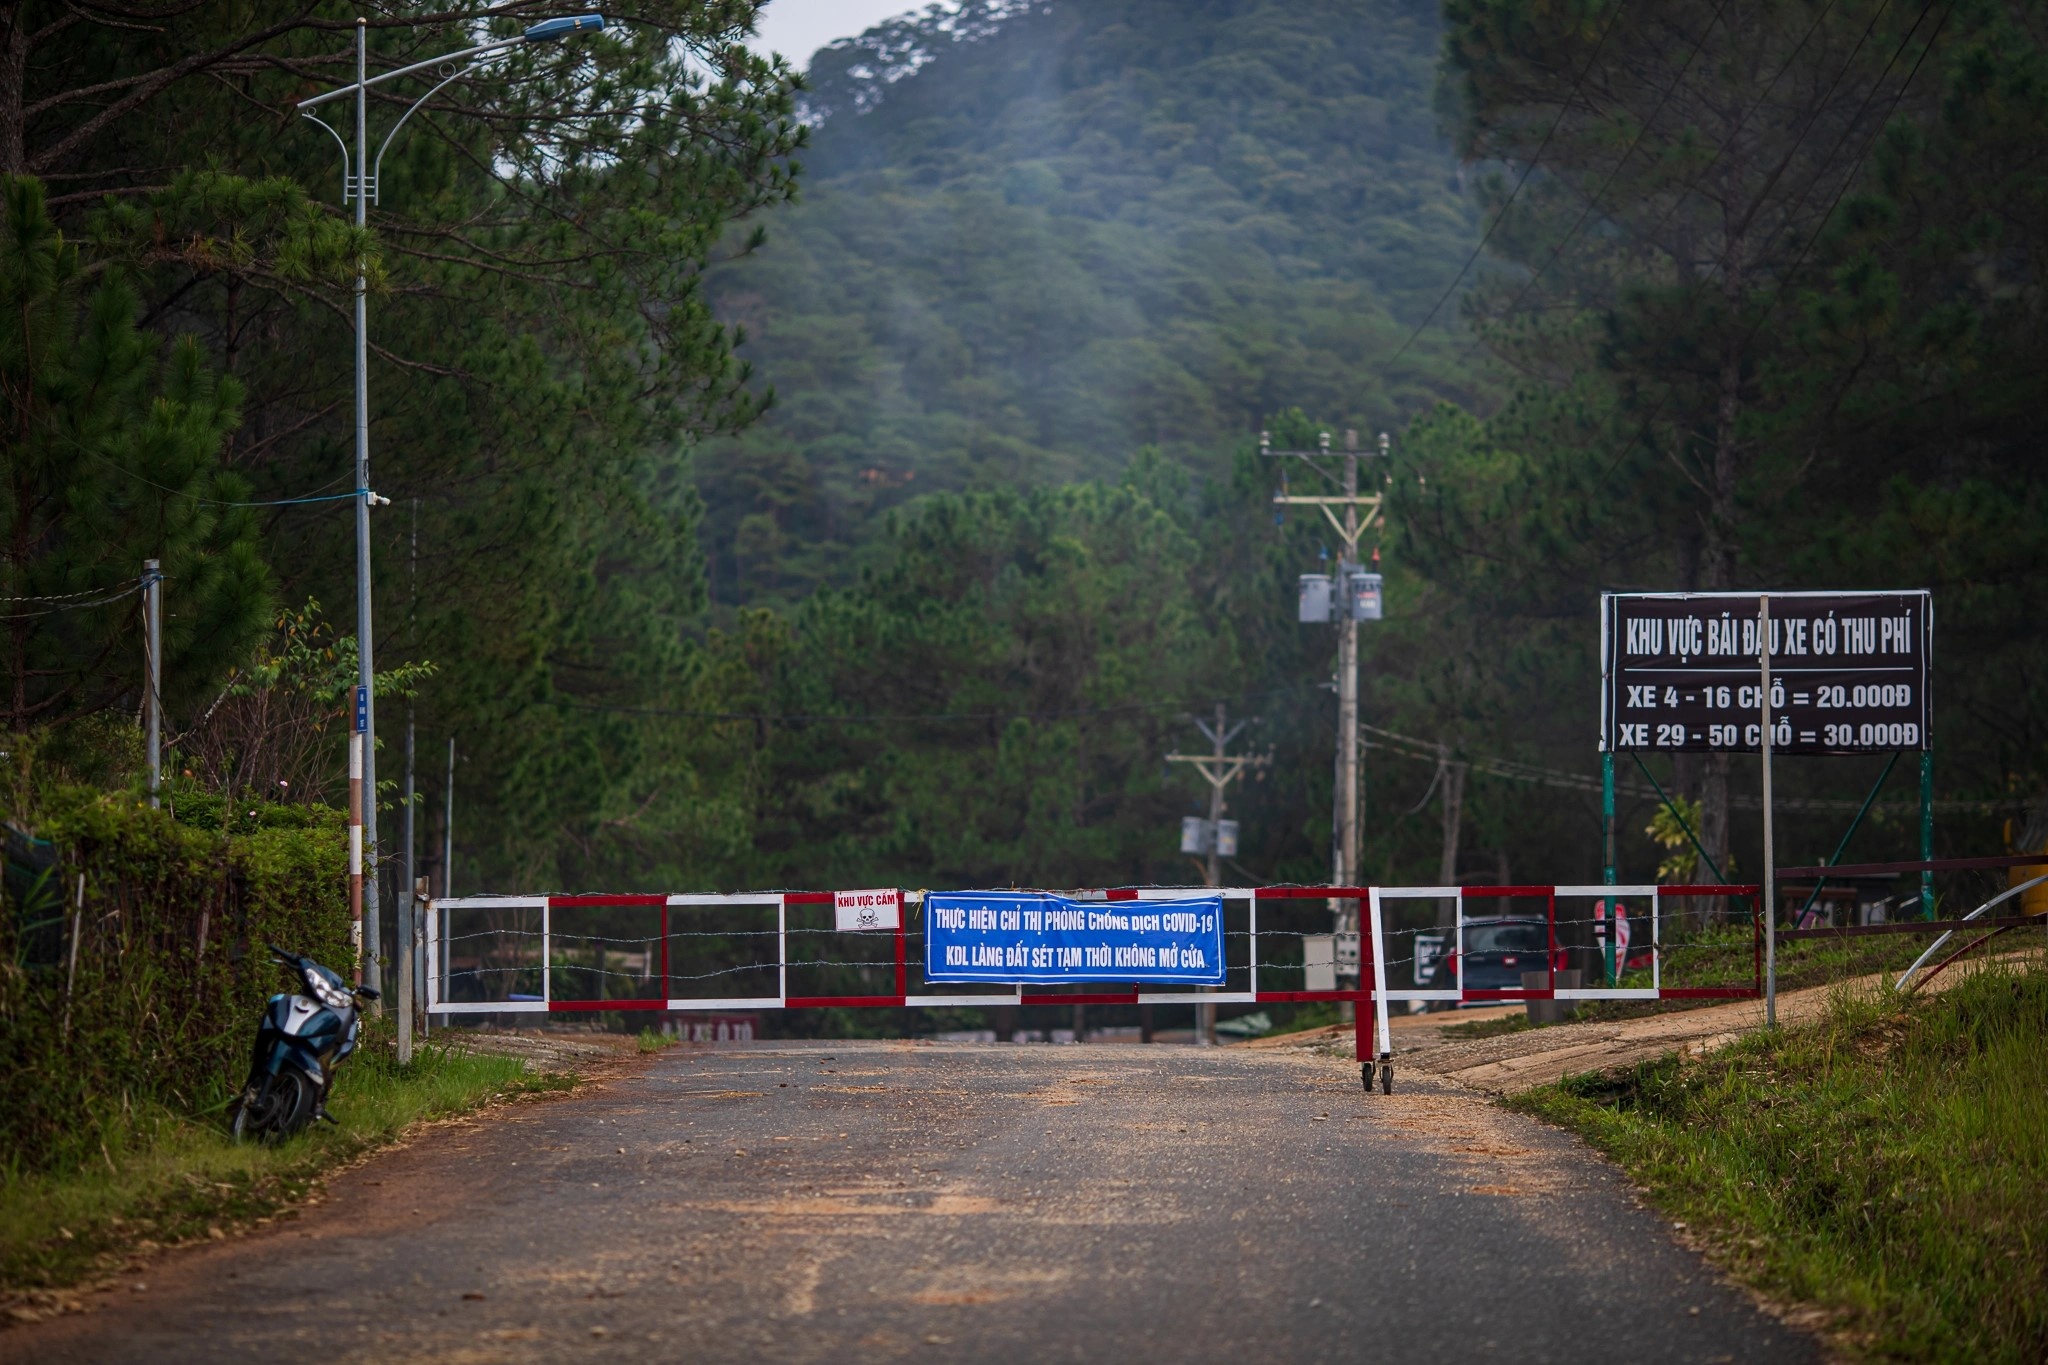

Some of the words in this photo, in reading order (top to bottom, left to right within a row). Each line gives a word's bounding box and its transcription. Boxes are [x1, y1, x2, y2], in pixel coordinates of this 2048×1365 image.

[1627, 618, 1662, 655] KHU
[1668, 615, 1702, 663] VỰC
[1708, 612, 1738, 655] BÃI
[1784, 618, 1807, 655] XE
[1813, 610, 1837, 655] CÓ
[1842, 617, 1875, 654] THU
[1881, 609, 1911, 654] PHÍ
[1627, 685, 1656, 708] XE
[1664, 685, 1678, 708] 4
[1703, 686, 1731, 709] 16
[1793, 692, 1809, 704] =
[1817, 684, 1911, 708] 20.000Đ
[1619, 723, 1649, 746] XE
[1656, 724, 1685, 746] 29
[1709, 724, 1737, 746] 50
[1800, 731, 1816, 742] =
[1823, 723, 1918, 746] 30.000Đ
[838, 896, 855, 907] KHU
[857, 895, 873, 908] VỰC
[876, 891, 895, 905] CẤM
[935, 907, 966, 933] THỰC
[969, 906, 997, 934] HIỆN
[1000, 904, 1020, 931] CHỈ
[1023, 911, 1041, 935] THỊ
[1045, 906, 1085, 931] PHÒNG
[1131, 915, 1160, 934] DỊCH
[1163, 912, 1213, 934] COVID-19
[946, 945, 969, 966] KDL
[972, 942, 1003, 967] LÀNG
[1006, 940, 1029, 967] ĐẤT
[1032, 944, 1054, 968] SÉT
[1056, 947, 1082, 972] TẠM
[1085, 942, 1112, 967] THỜI
[1115, 943, 1156, 968] KHÔNG
[1159, 941, 1178, 968] MỞ
[1181, 943, 1205, 969] CỬA
